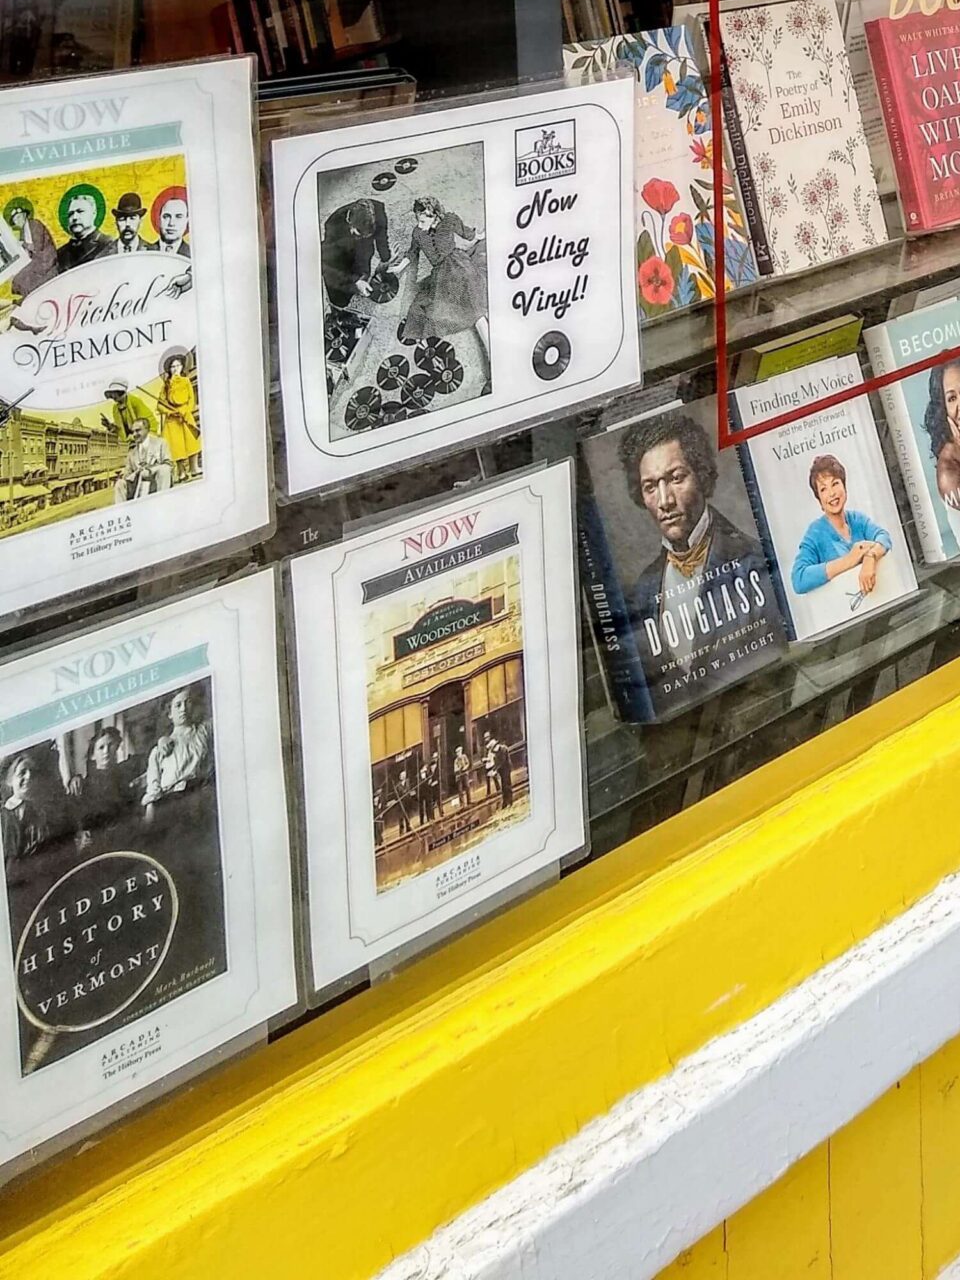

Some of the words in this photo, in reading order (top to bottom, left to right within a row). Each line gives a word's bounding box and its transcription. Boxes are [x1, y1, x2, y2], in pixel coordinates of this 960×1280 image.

[899, 32, 922, 43] WALT
[775, 82, 808, 98] Poetry
[810, 80, 818, 91] of
[786, 70, 802, 80] The
[19, 95, 129, 138] NOW
[780, 98, 822, 120] Emily
[19, 134, 131, 165] AVAILABLE
[768, 116, 843, 146] Dickinson
[516, 152, 576, 179] BOOKS
[515, 189, 578, 230] Now
[934, 188, 960, 202] BRIAN
[506, 234, 590, 281] Selling
[34, 273, 165, 335] Wicked
[511, 274, 589, 320] Vinyl!
[12, 319, 172, 377] VERMONT
[750, 386, 802, 416] Finding
[801, 381, 821, 405] My
[821, 370, 855, 397] Voice
[772, 434, 817, 463] Valerie
[819, 422, 858, 450] Jarrett
[70, 515, 132, 539] ARCADIA
[70, 523, 132, 546] PUBLISHING
[71, 550, 85, 560] The
[86, 541, 114, 556] History
[114, 535, 133, 547] Press
[299, 527, 320, 546] The
[401, 510, 483, 562] NOW
[403, 542, 484, 586] AVAILABLE
[653, 559, 743, 607] FREDERICK
[406, 611, 481, 650] WOODSTOCK
[590, 582, 621, 653] DOUGLASS
[643, 569, 768, 658] DOUGLASS
[53, 631, 157, 693] NOW
[659, 644, 712, 674] PROPHET
[721, 618, 768, 646] FREEDOM
[663, 665, 707, 695] DAVID
[711, 657, 727, 673] W.
[728, 631, 776, 662] BLIGHT
[55, 667, 160, 719] AVAILABLE
[34, 869, 161, 937] HIDDEN
[22, 894, 164, 975] HISTORY
[90, 949, 103, 965] of
[37, 944, 160, 1016] VERMONT
[101, 1025, 161, 1060] ARCADIA
